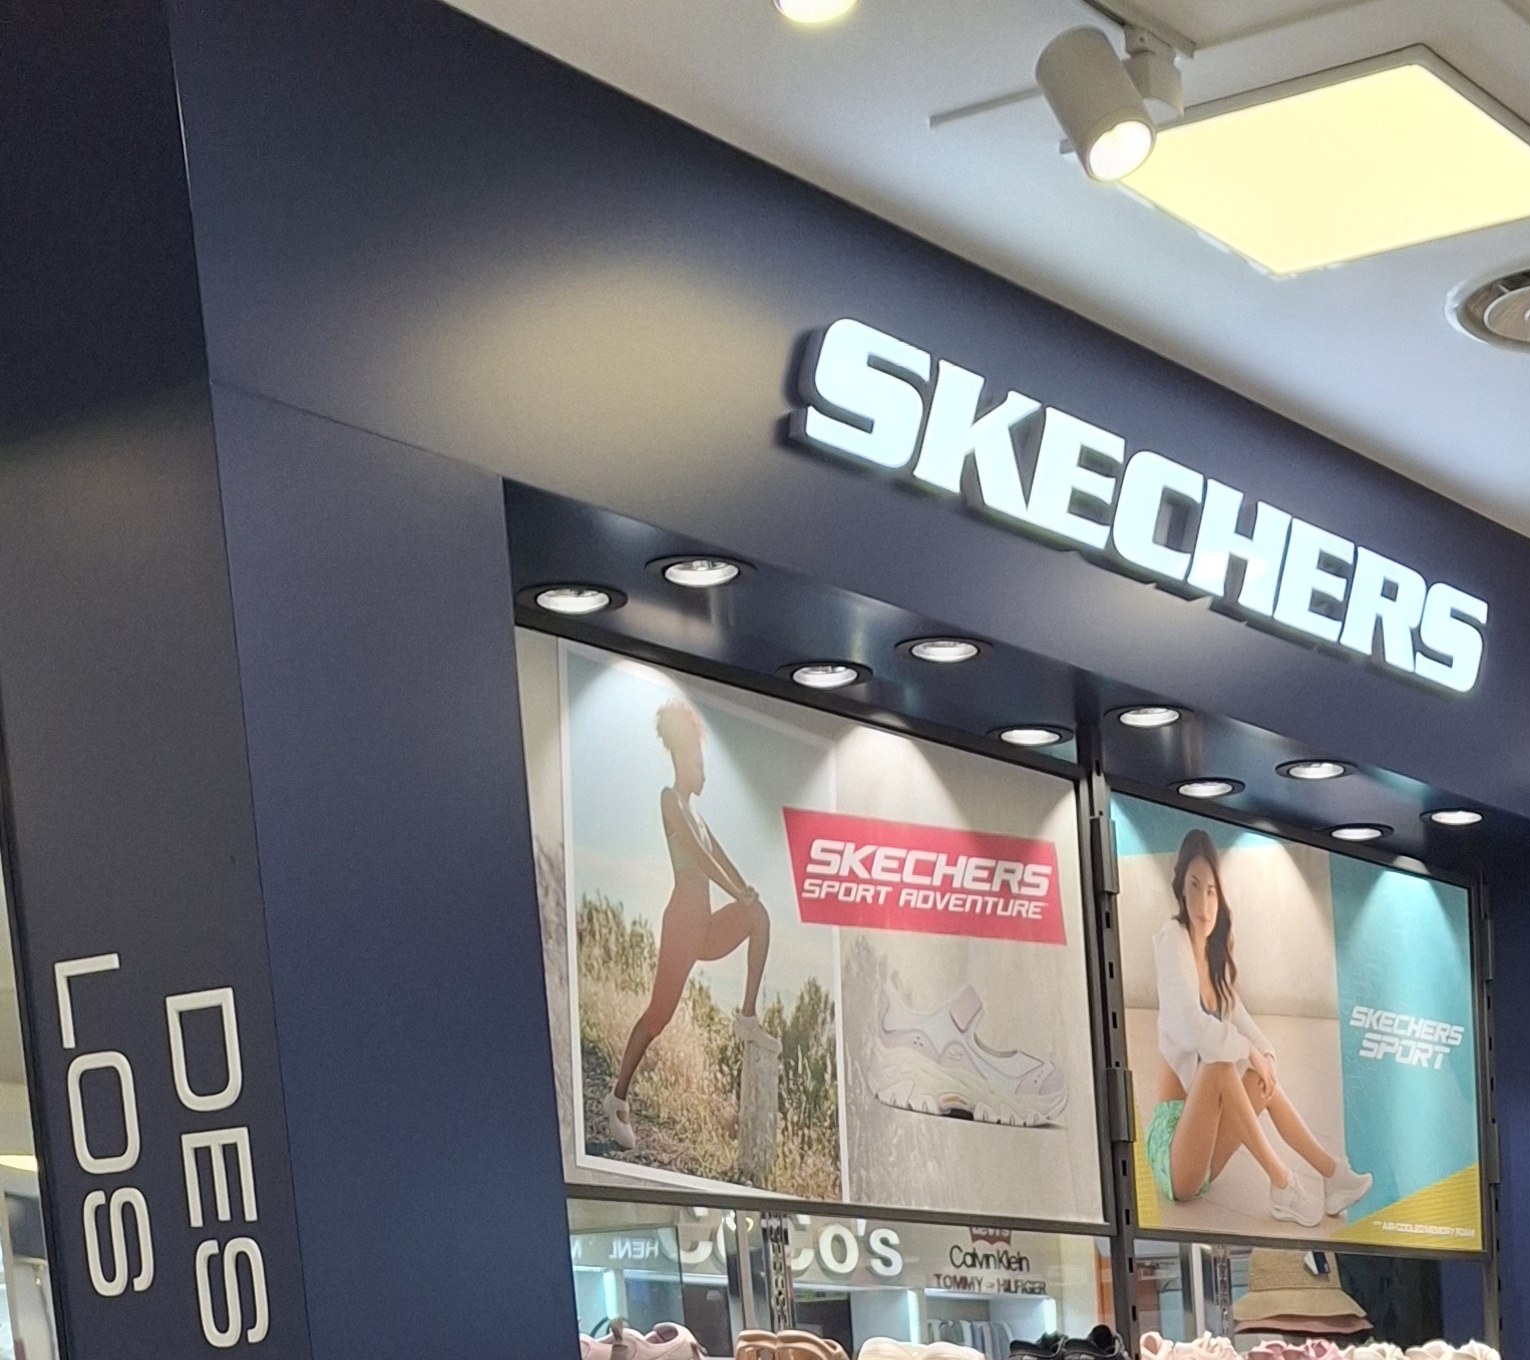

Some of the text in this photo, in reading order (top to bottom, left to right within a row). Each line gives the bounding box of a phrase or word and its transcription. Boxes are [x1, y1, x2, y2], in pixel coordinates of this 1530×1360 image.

[804, 317, 1489, 694] SKECHERS
[805, 837, 1054, 897] SKECHERS
[801, 878, 1047, 920] SPORT ADVENTURE
[1349, 1006, 1465, 1047] SKECHERS
[1358, 1032, 1452, 1070] SPORT
[53, 952, 155, 1299] LOS
[933, 1273, 985, 1292] TOMMY
